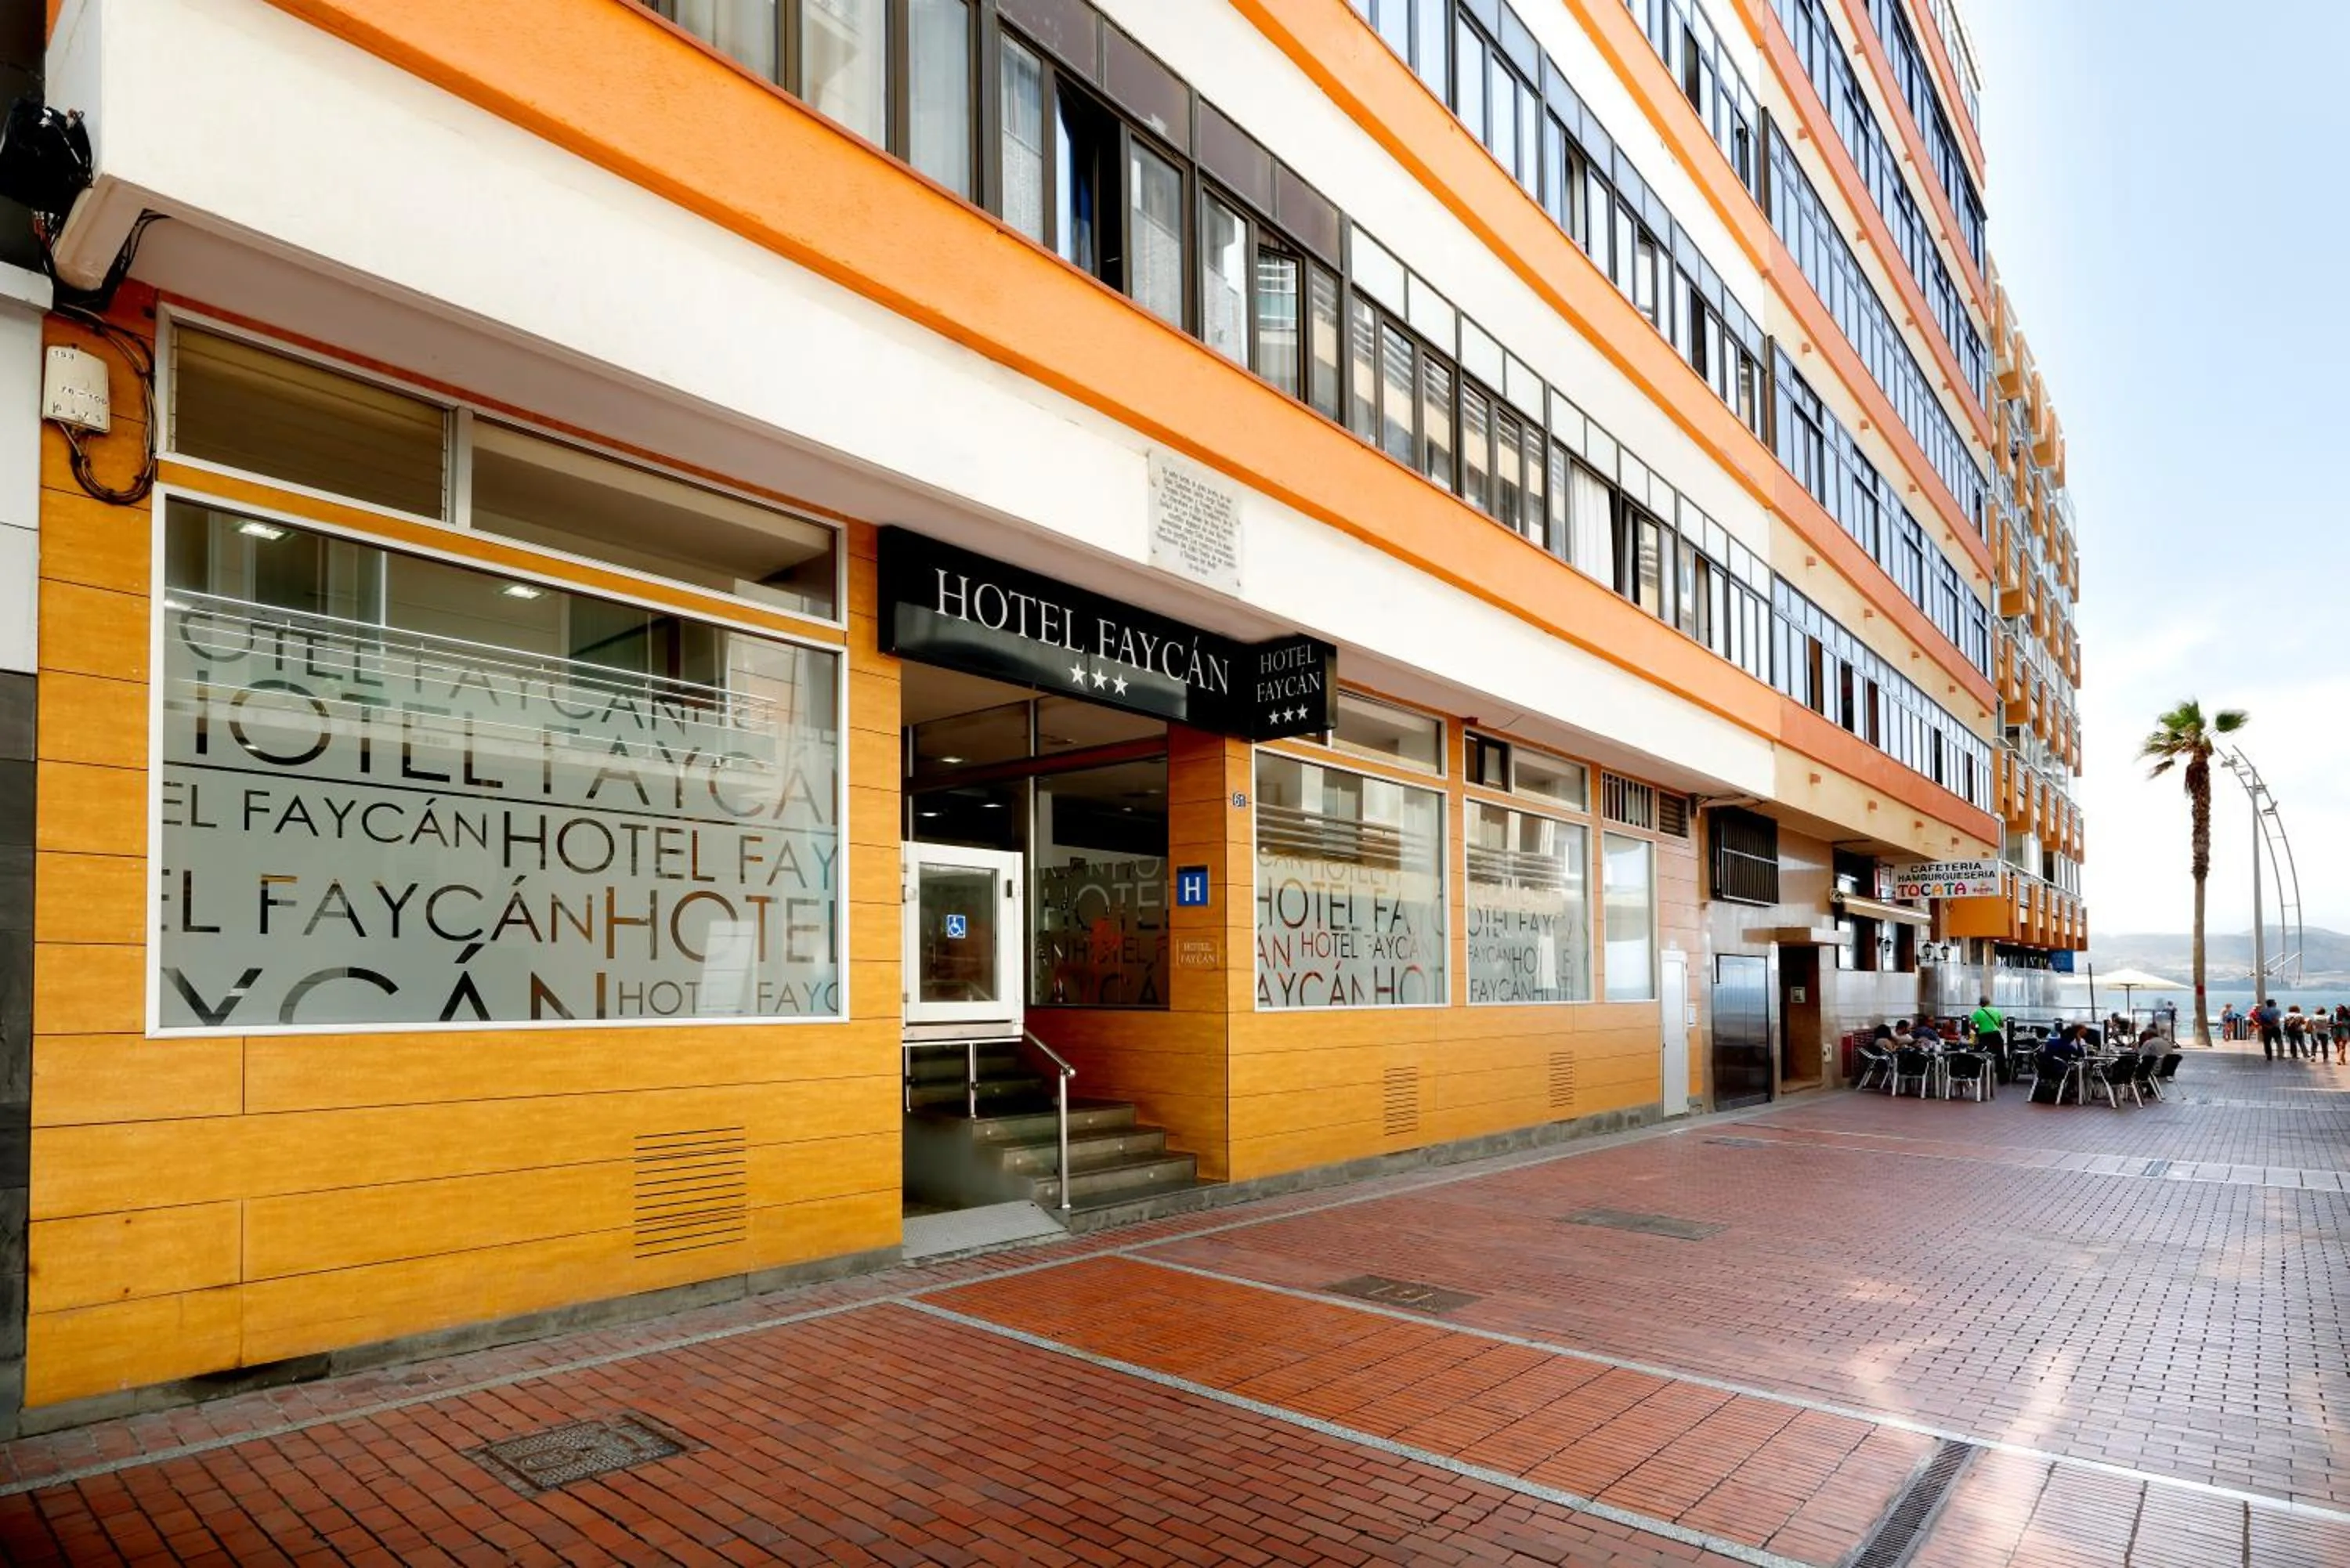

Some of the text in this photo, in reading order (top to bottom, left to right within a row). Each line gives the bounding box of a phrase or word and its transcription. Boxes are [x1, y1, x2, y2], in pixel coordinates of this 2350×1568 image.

[935, 568, 1230, 695] HOTEL FAYCÁN
[1260, 644, 1317, 674] HOTEL
[1256, 667, 1321, 703] FAYCÁN
[244, 788, 487, 850] FAYCÁN
[504, 811, 716, 883] HOTEL
[1897, 870, 1996, 883] HAMBURGUESERIA
[1911, 862, 1983, 873] CAFETERIA
[1184, 876, 1201, 902] H
[1897, 881, 1967, 897] TOCATA
[259, 873, 593, 944] FAYCÁN
[1301, 931, 1359, 959] HOTEL
